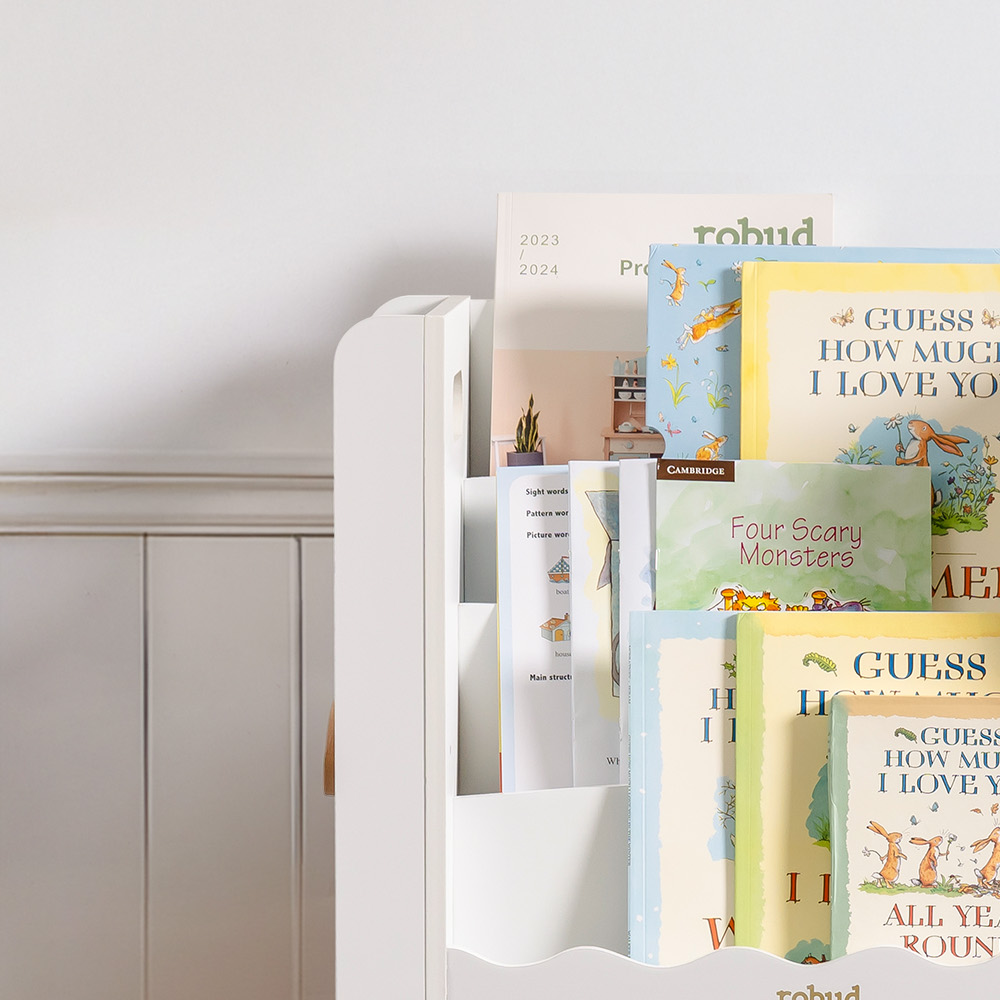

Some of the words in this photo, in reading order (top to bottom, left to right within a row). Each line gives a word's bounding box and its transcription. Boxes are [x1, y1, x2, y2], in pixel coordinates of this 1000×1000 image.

[520, 234, 559, 246] 2023
[693, 216, 816, 245] robud
[519, 264, 558, 275] 2024
[865, 307, 973, 332] GUESS
[818, 339, 903, 362] HOW
[809, 370, 821, 396] I
[836, 370, 937, 398] LOVE
[667, 465, 725, 475] CAMBRIDGE
[526, 488, 545, 497] Sight
[731, 515, 784, 540] Four
[792, 517, 862, 549] Scary
[740, 542, 854, 568] Monsters
[853, 651, 987, 680] GUESS
[884, 750, 950, 768] HOW
[878, 773, 888, 793] I
[899, 774, 978, 795] LOVE
[883, 903, 943, 928] ALL
